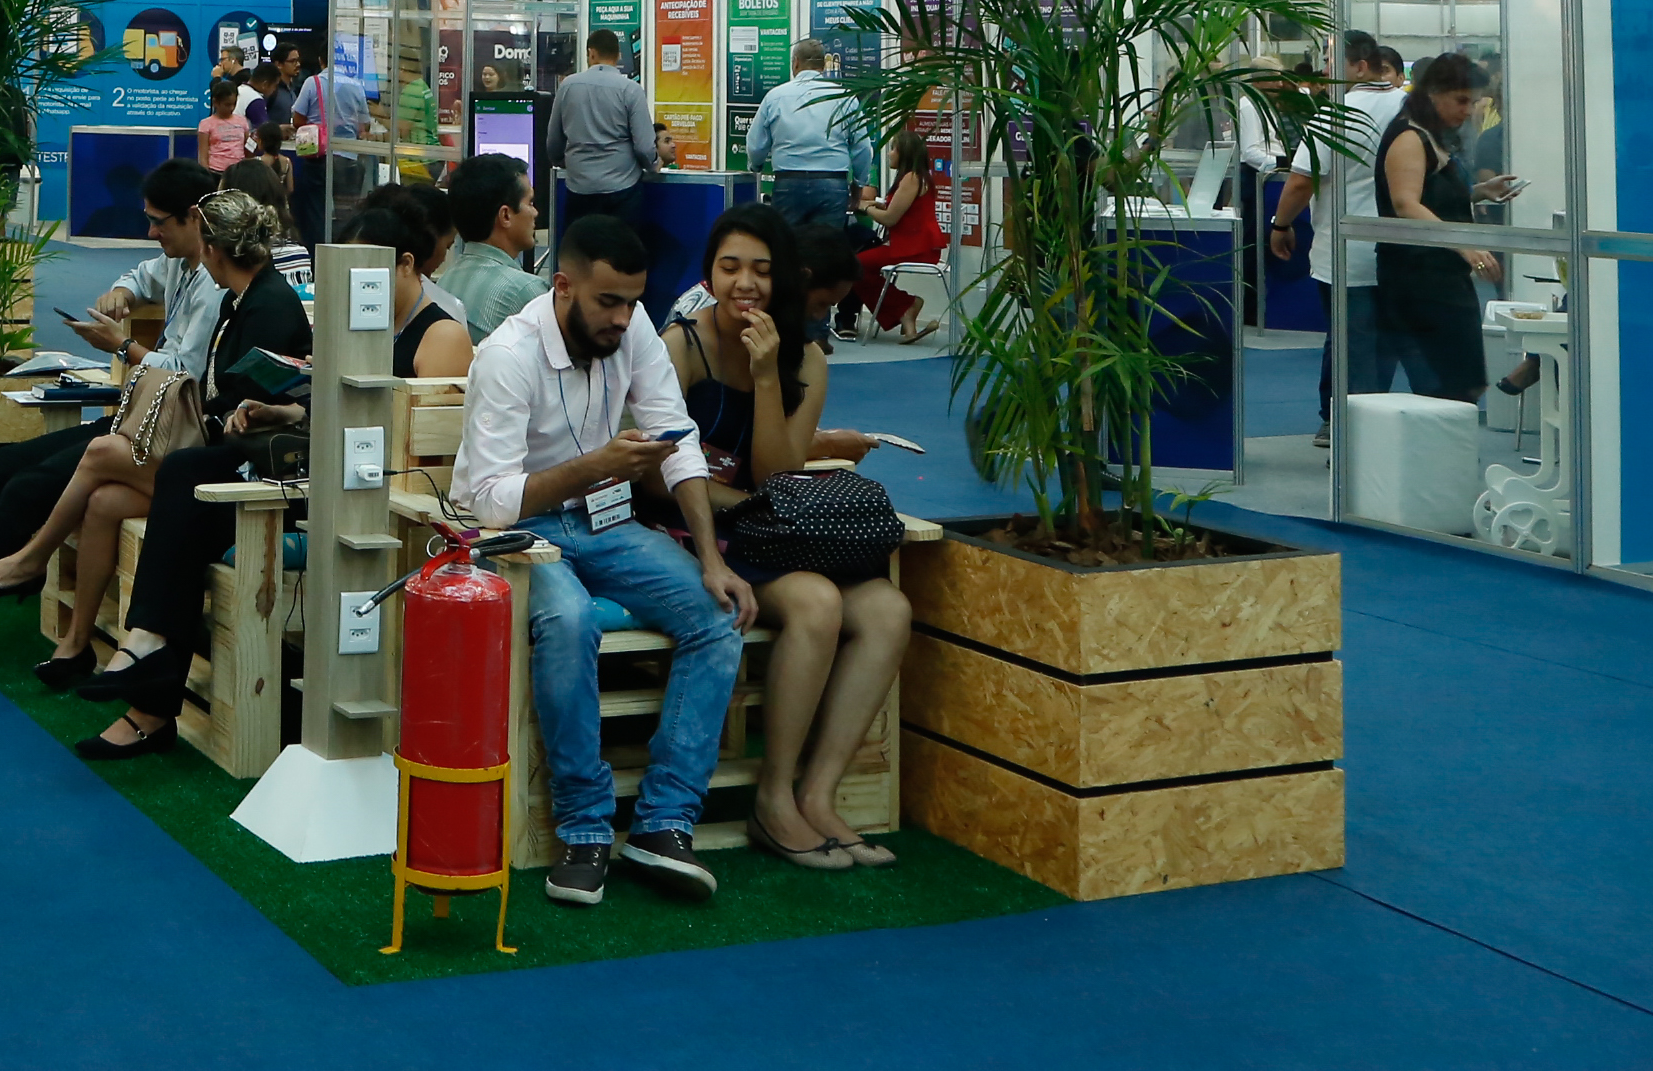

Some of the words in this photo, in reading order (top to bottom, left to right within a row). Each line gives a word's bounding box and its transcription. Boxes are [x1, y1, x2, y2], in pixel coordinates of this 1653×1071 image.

[660, 0, 697, 10] ANTECIPAÇÃO
[697, 0, 707, 8] DE
[667, 9, 699, 19] RECEBÍVEIS
[112, 87, 126, 108] 2
[735, 115, 749, 125] Quer
